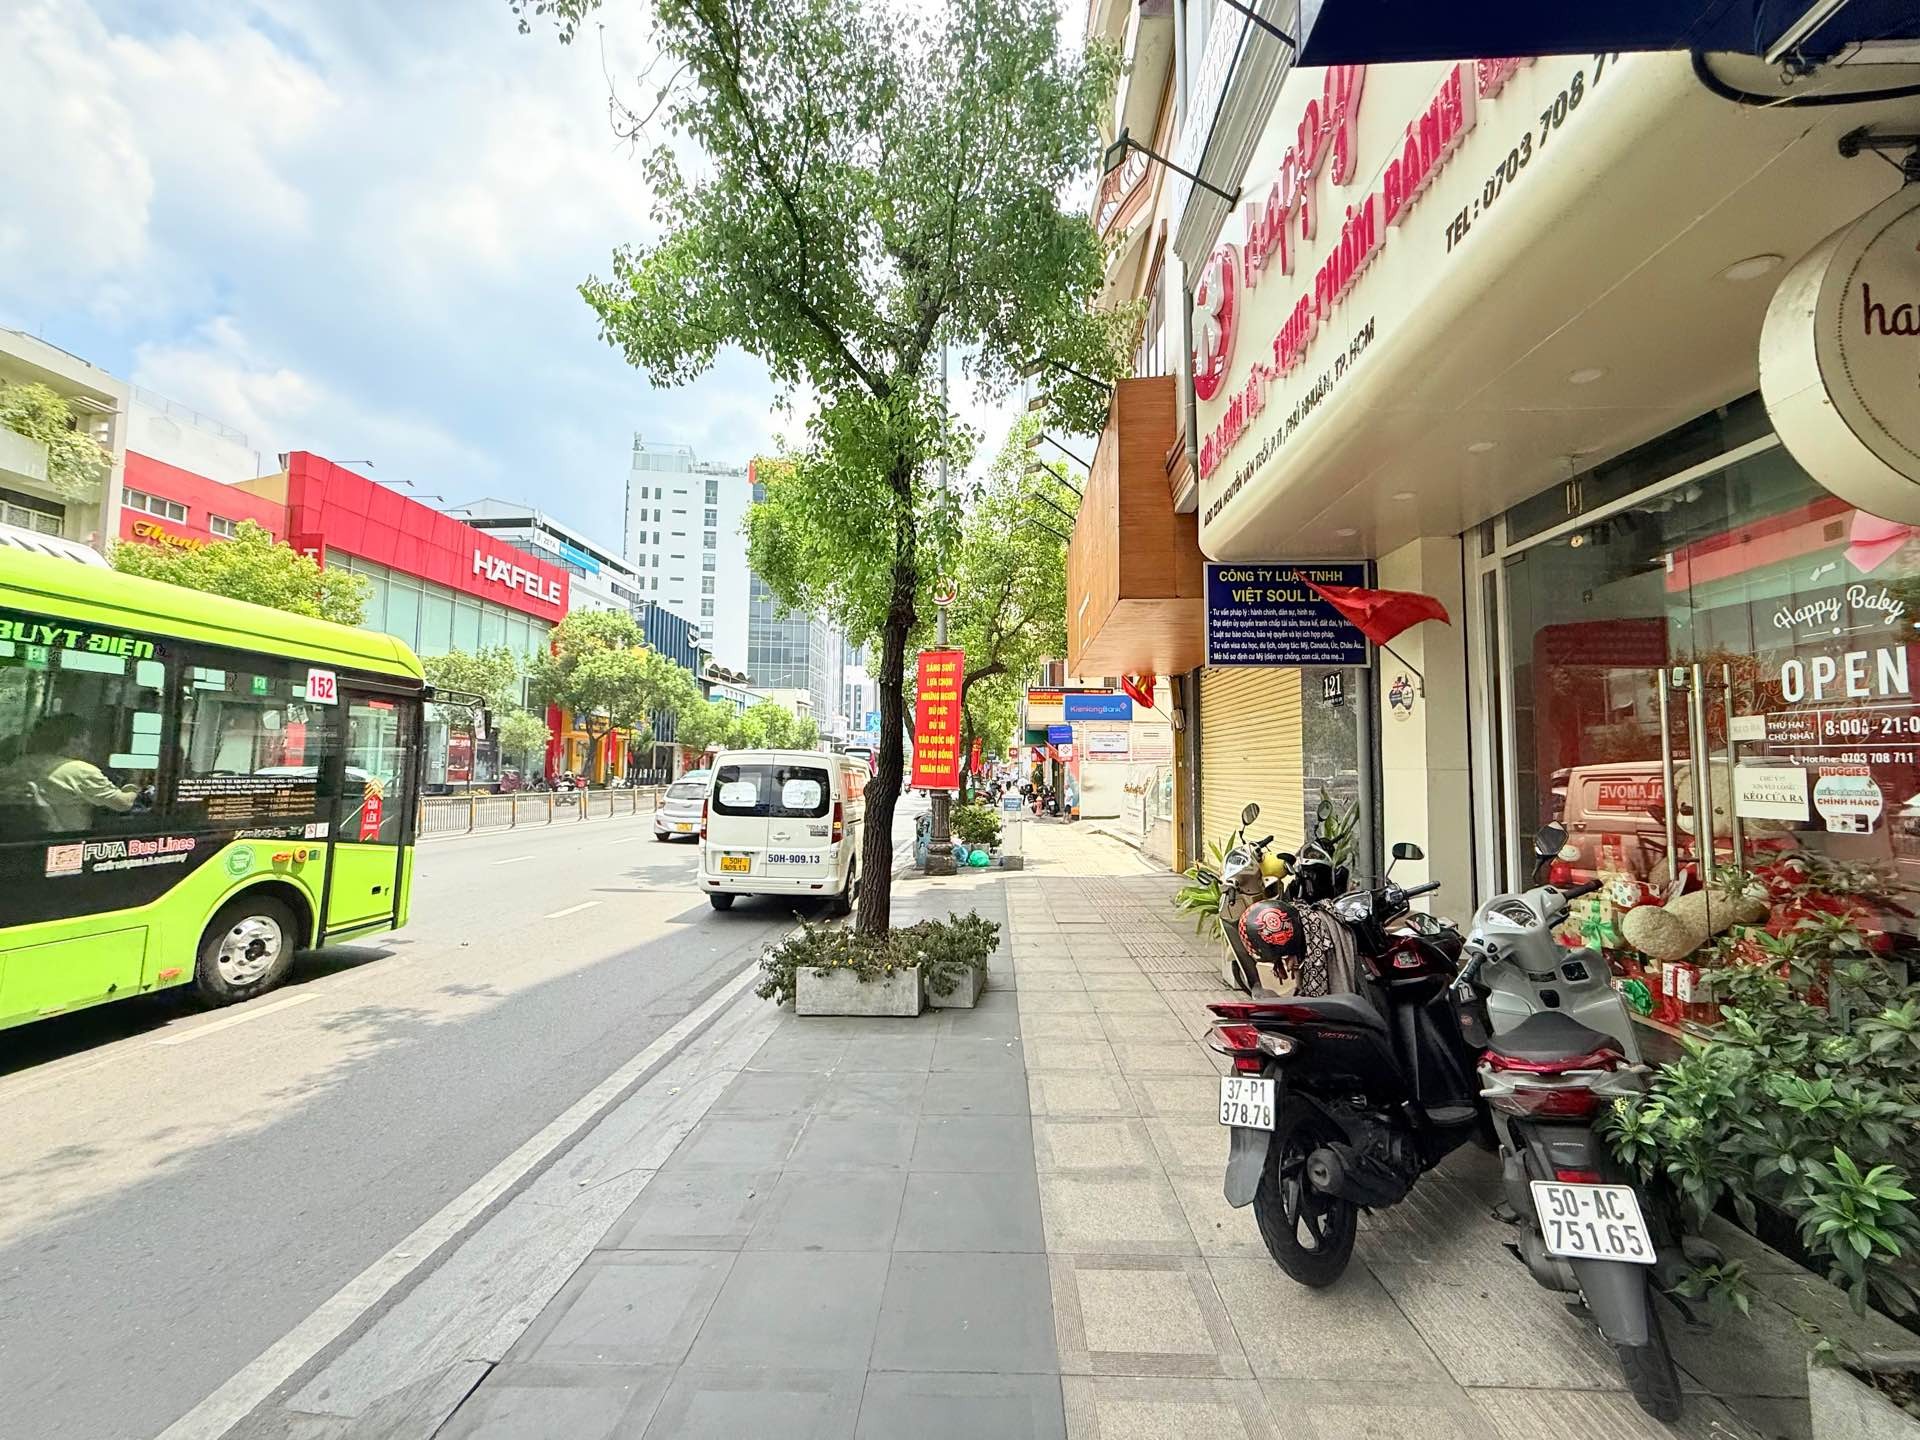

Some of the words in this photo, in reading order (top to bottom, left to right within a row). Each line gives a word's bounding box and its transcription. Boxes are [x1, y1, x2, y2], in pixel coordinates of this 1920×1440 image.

[1445, 206, 1471, 254] TEL
[1483, 132, 1532, 210] 0703
[1539, 70, 1584, 149] 708
[1862, 282, 1920, 336] ha
[1349, 315, 1375, 365] HCM
[472, 549, 562, 606] HÄFELE
[1219, 568, 1254, 582] CÔNG
[1257, 570, 1272, 582] TY
[1310, 570, 1343, 582] TNHH
[1232, 586, 1263, 605] VIỆT
[1266, 589, 1305, 602] SOUL
[1773, 597, 1842, 629] Happy
[1846, 584, 1905, 624] Baby
[1324, 674, 1341, 698] 121
[1781, 645, 1910, 702] OPEN
[310, 676, 333, 698] 152
[1841, 752, 1867, 764] 0703
[1869, 752, 1890, 763] 708
[1894, 752, 1914, 763] 711
[1820, 766, 1870, 777] HUGGIES
[83, 841, 127, 861] FUTA
[127, 839, 157, 856] Bus
[158, 836, 196, 853] Lines
[767, 853, 820, 864] 50H-909.13
[1226, 1078, 1266, 1102] 37-P1
[1222, 1102, 1271, 1127] 378.78
[1546, 1187, 1625, 1220] 50-AC
[1549, 1219, 1645, 1256] 751.65
